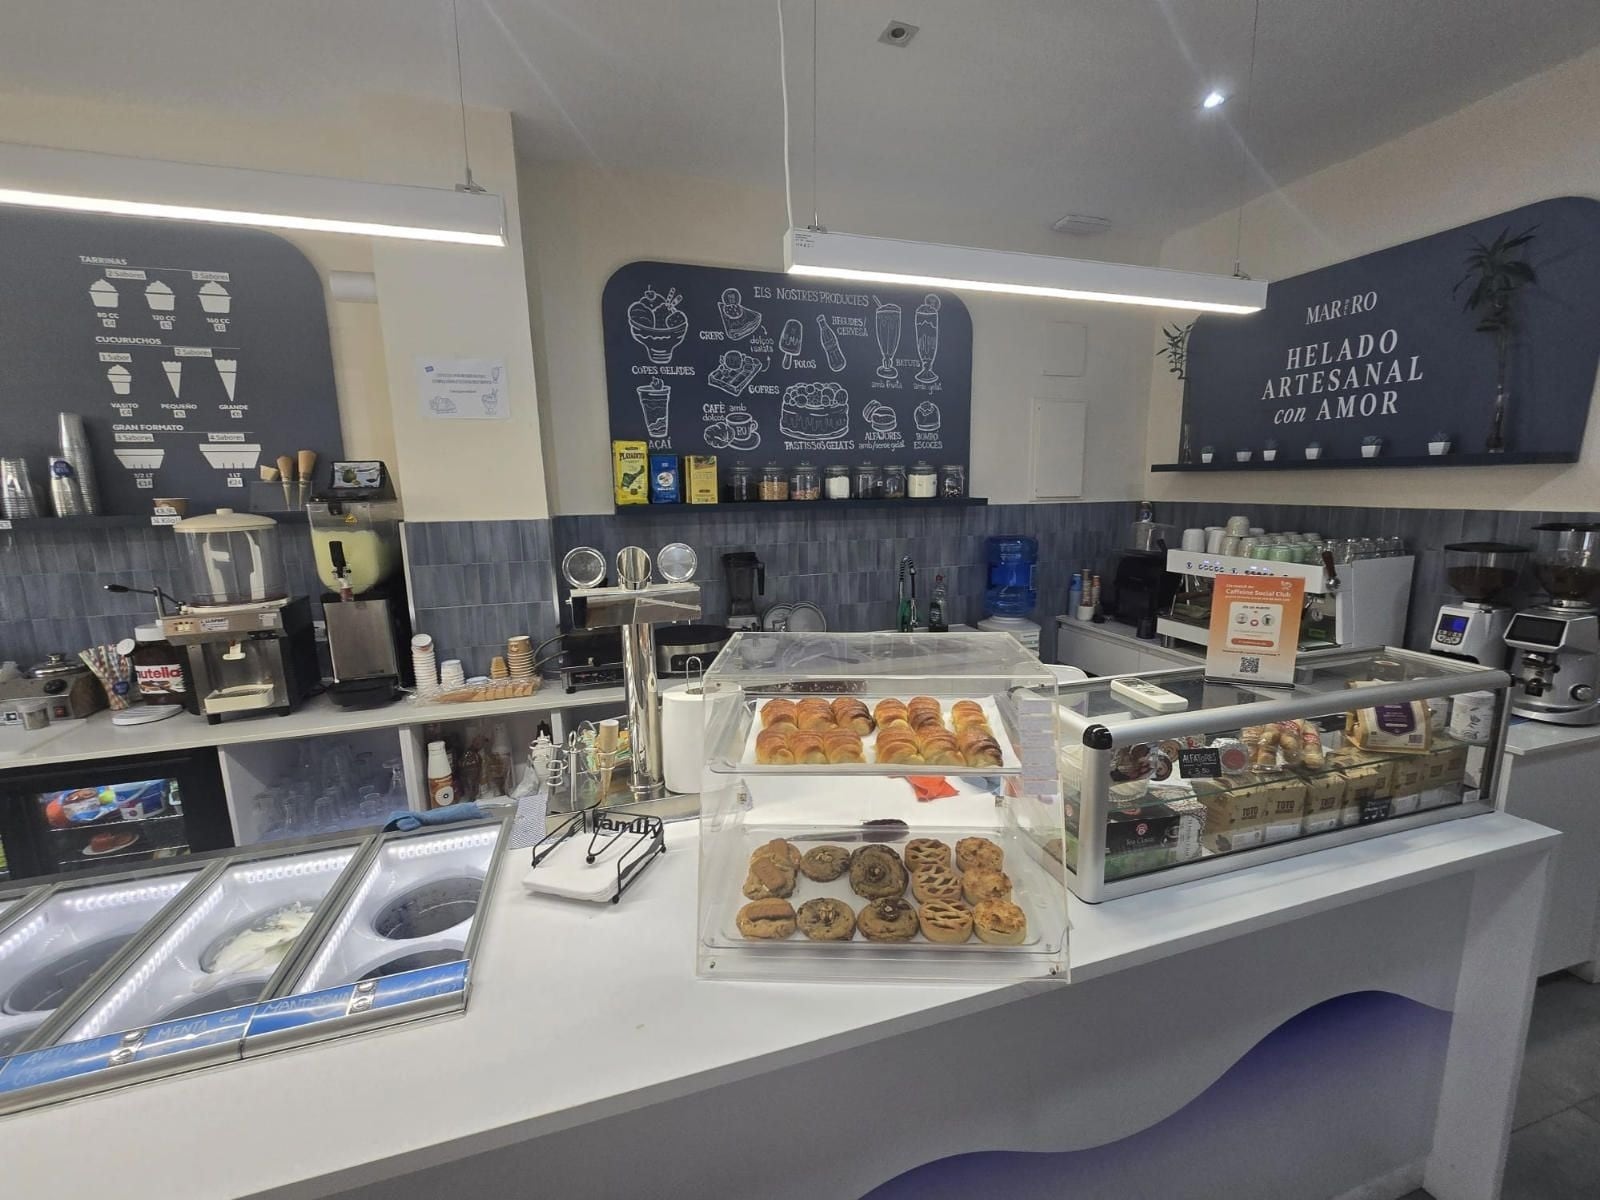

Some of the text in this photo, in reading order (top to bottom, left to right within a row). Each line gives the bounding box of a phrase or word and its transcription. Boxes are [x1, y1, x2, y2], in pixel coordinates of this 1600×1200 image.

[79, 255, 128, 266] TARRINAS
[753, 286, 772, 299] ELS
[776, 287, 819, 302] NOSTRES
[95, 336, 162, 345] CUCURUCHOS
[1286, 329, 1398, 370] HELADO
[631, 365, 659, 376] COPES
[1261, 356, 1424, 400] ARTESANAL
[748, 384, 780, 395] GOFRES
[1274, 390, 1399, 425] con AMOR
[648, 436, 672, 451] AÇAÍ
